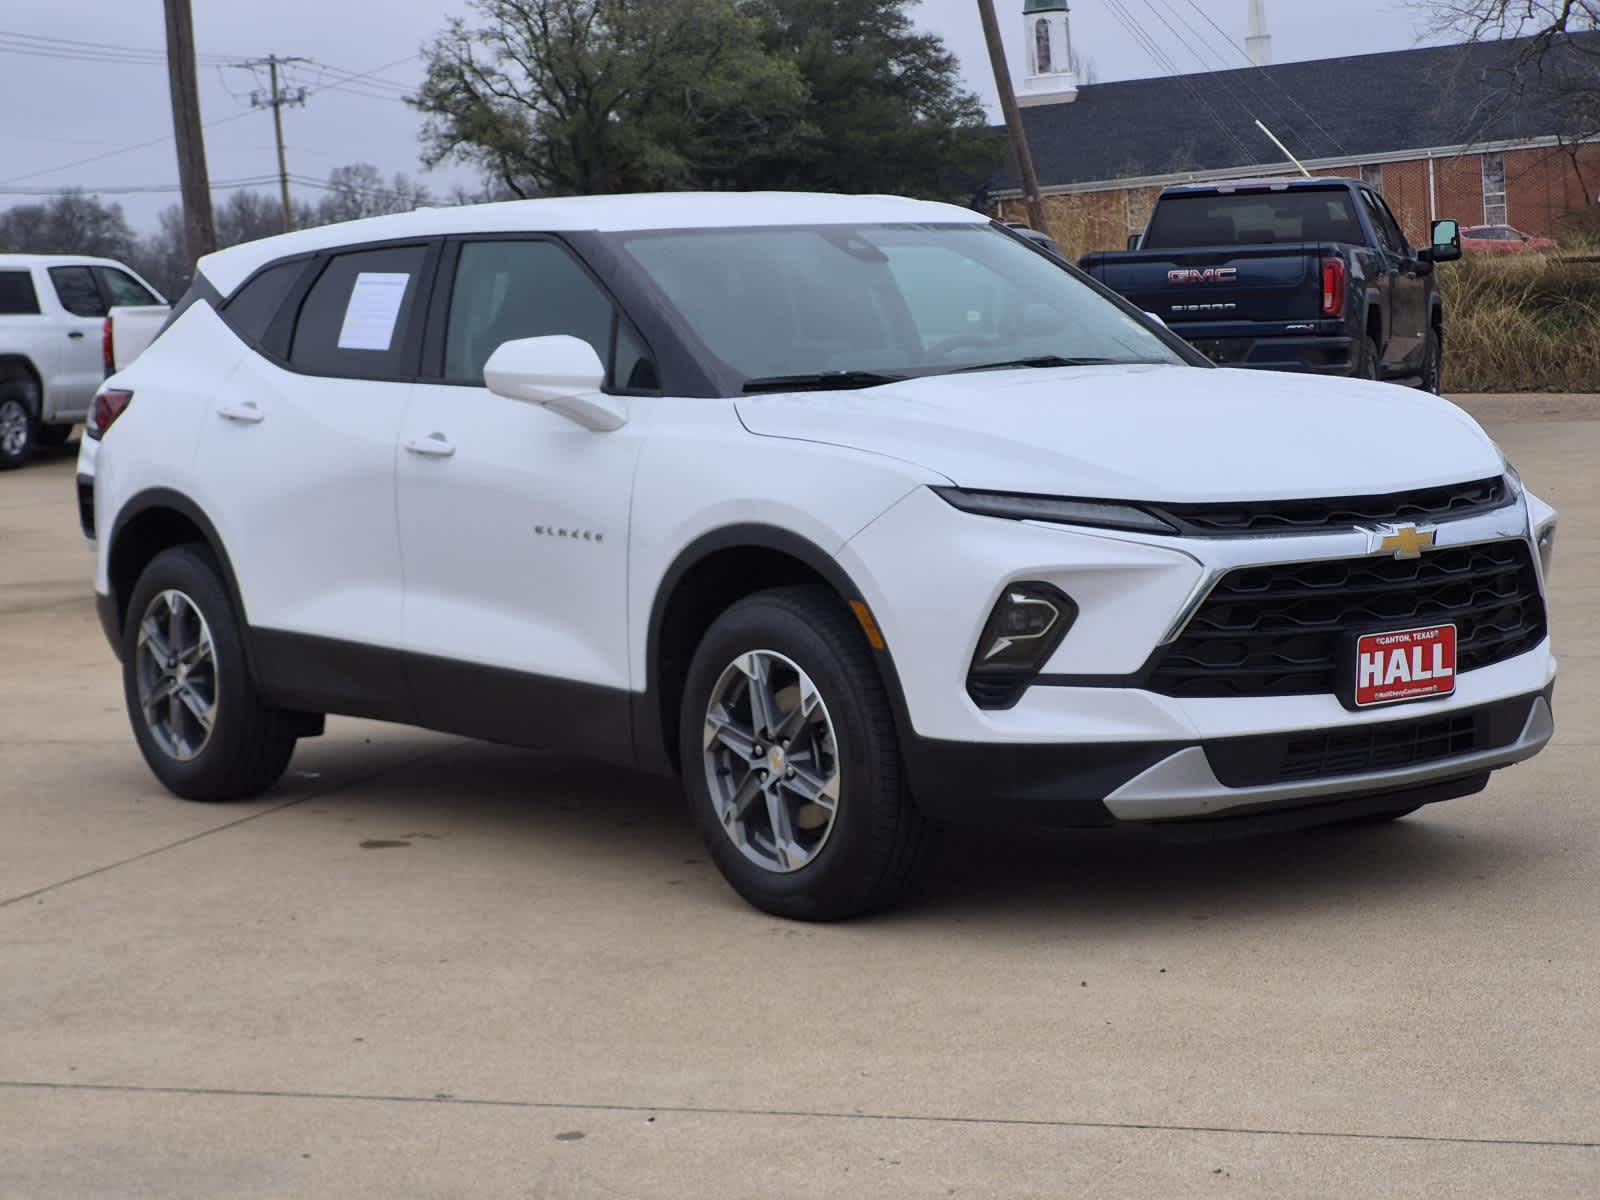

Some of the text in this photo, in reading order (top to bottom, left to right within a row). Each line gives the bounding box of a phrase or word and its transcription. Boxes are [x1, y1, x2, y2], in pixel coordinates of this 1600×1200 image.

[1167, 267, 1237, 283] GMC
[1413, 631, 1434, 641] TEXAS
[1360, 643, 1453, 688] HALL
